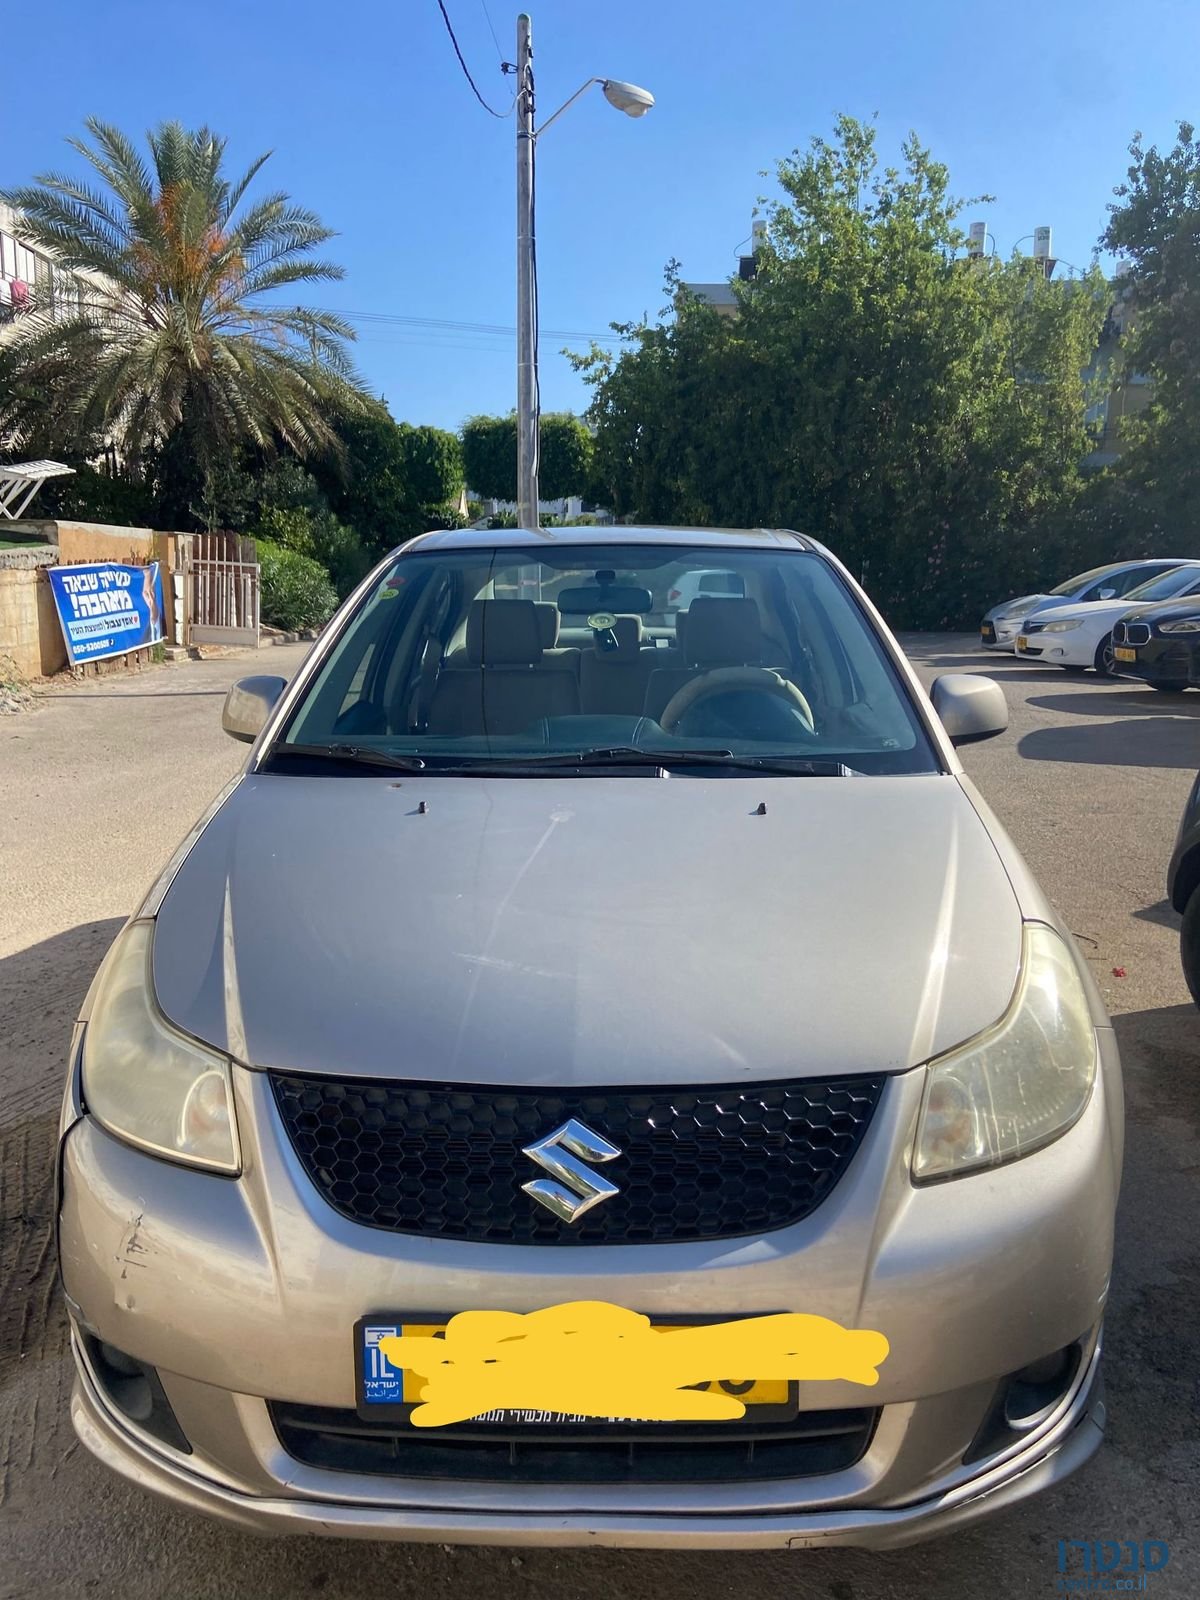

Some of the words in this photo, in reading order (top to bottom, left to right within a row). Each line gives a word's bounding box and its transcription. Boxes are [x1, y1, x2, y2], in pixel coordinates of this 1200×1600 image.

[62, 573, 98, 593] שבאה
[71, 590, 133, 618] מאהבה!
[371, 1348, 395, 1378] IL
[364, 1379, 399, 1389] ישראל
[509, 1408, 552, 1423] מכשירי
